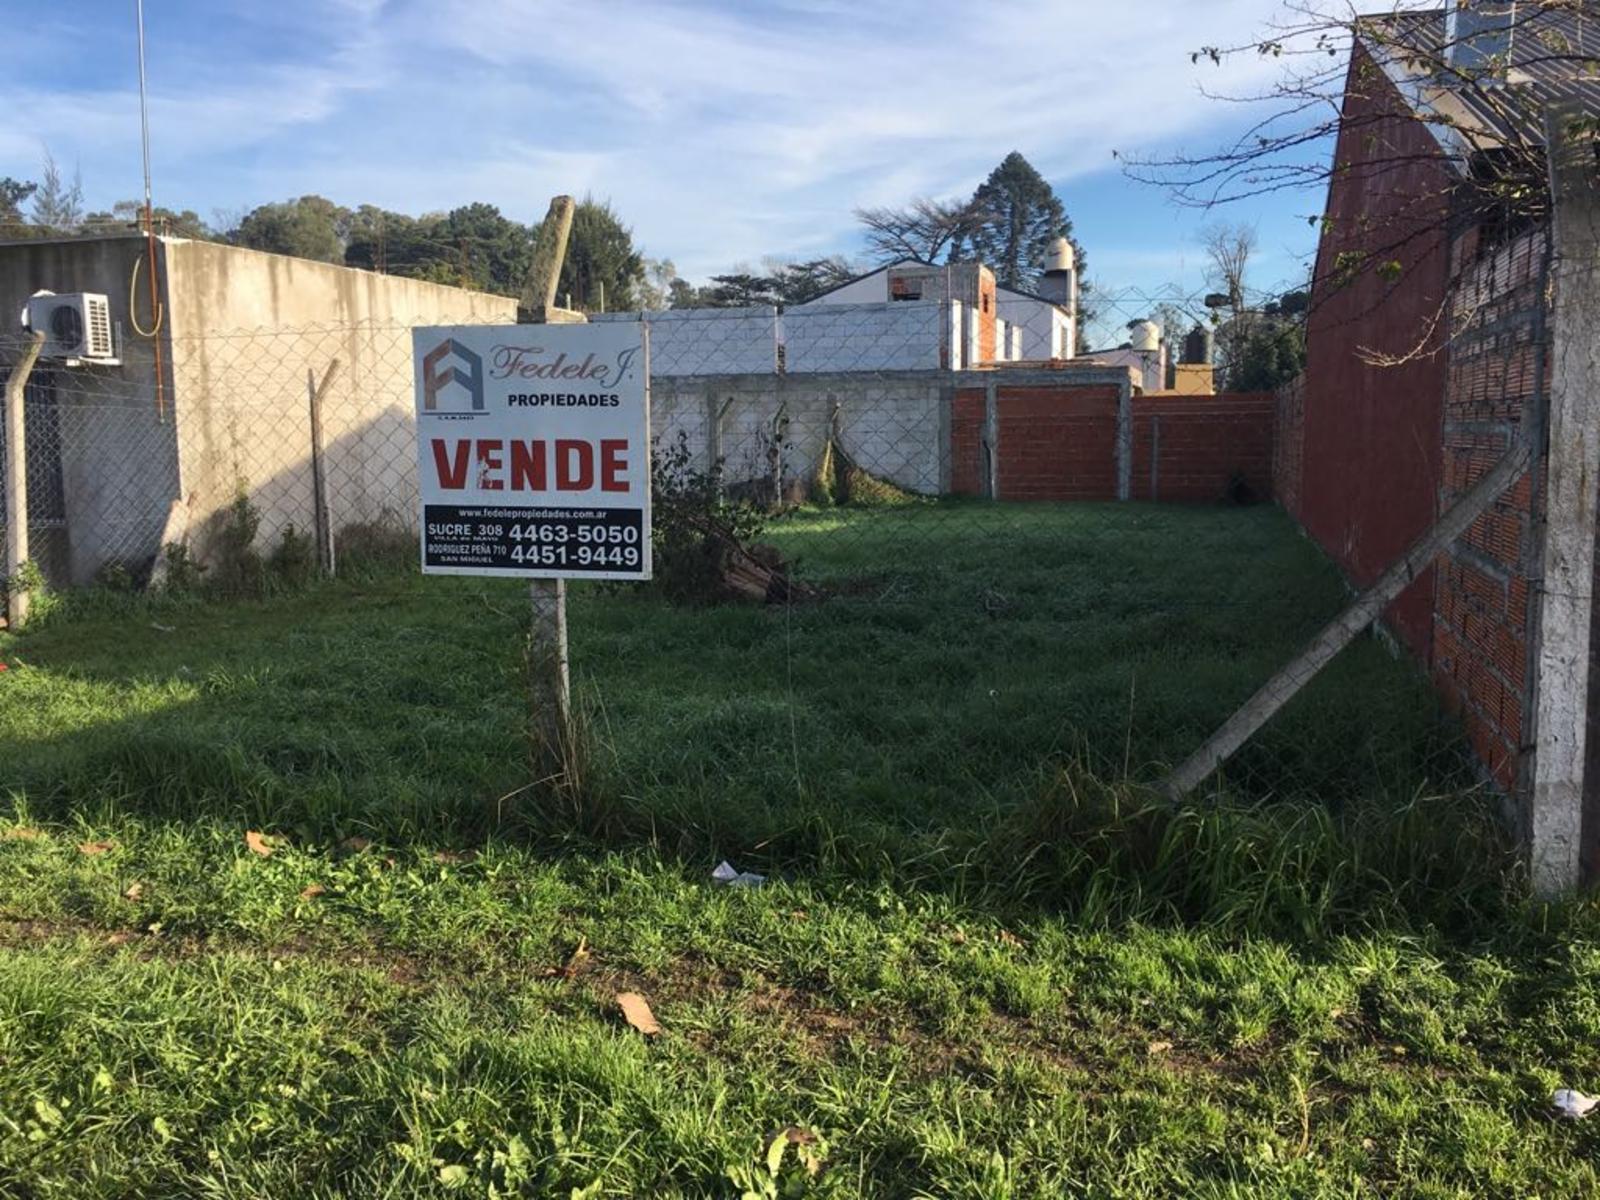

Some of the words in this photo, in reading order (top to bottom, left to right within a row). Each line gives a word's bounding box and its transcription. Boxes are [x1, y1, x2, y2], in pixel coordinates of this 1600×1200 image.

[489, 344, 611, 380] Fedele
[508, 393, 620, 407] PROPIEDADES
[431, 438, 630, 492] VENDE
[458, 508, 607, 519] www.fedelepropiedades.com.ar
[428, 523, 472, 536] SUCRE
[478, 524, 504, 536] 308
[508, 524, 638, 544] 4463-5050
[428, 543, 470, 555] RODRIGUEZ
[471, 543, 491, 555] PEÑA
[493, 545, 507, 555] 710
[510, 545, 639, 566] 4451-9449
